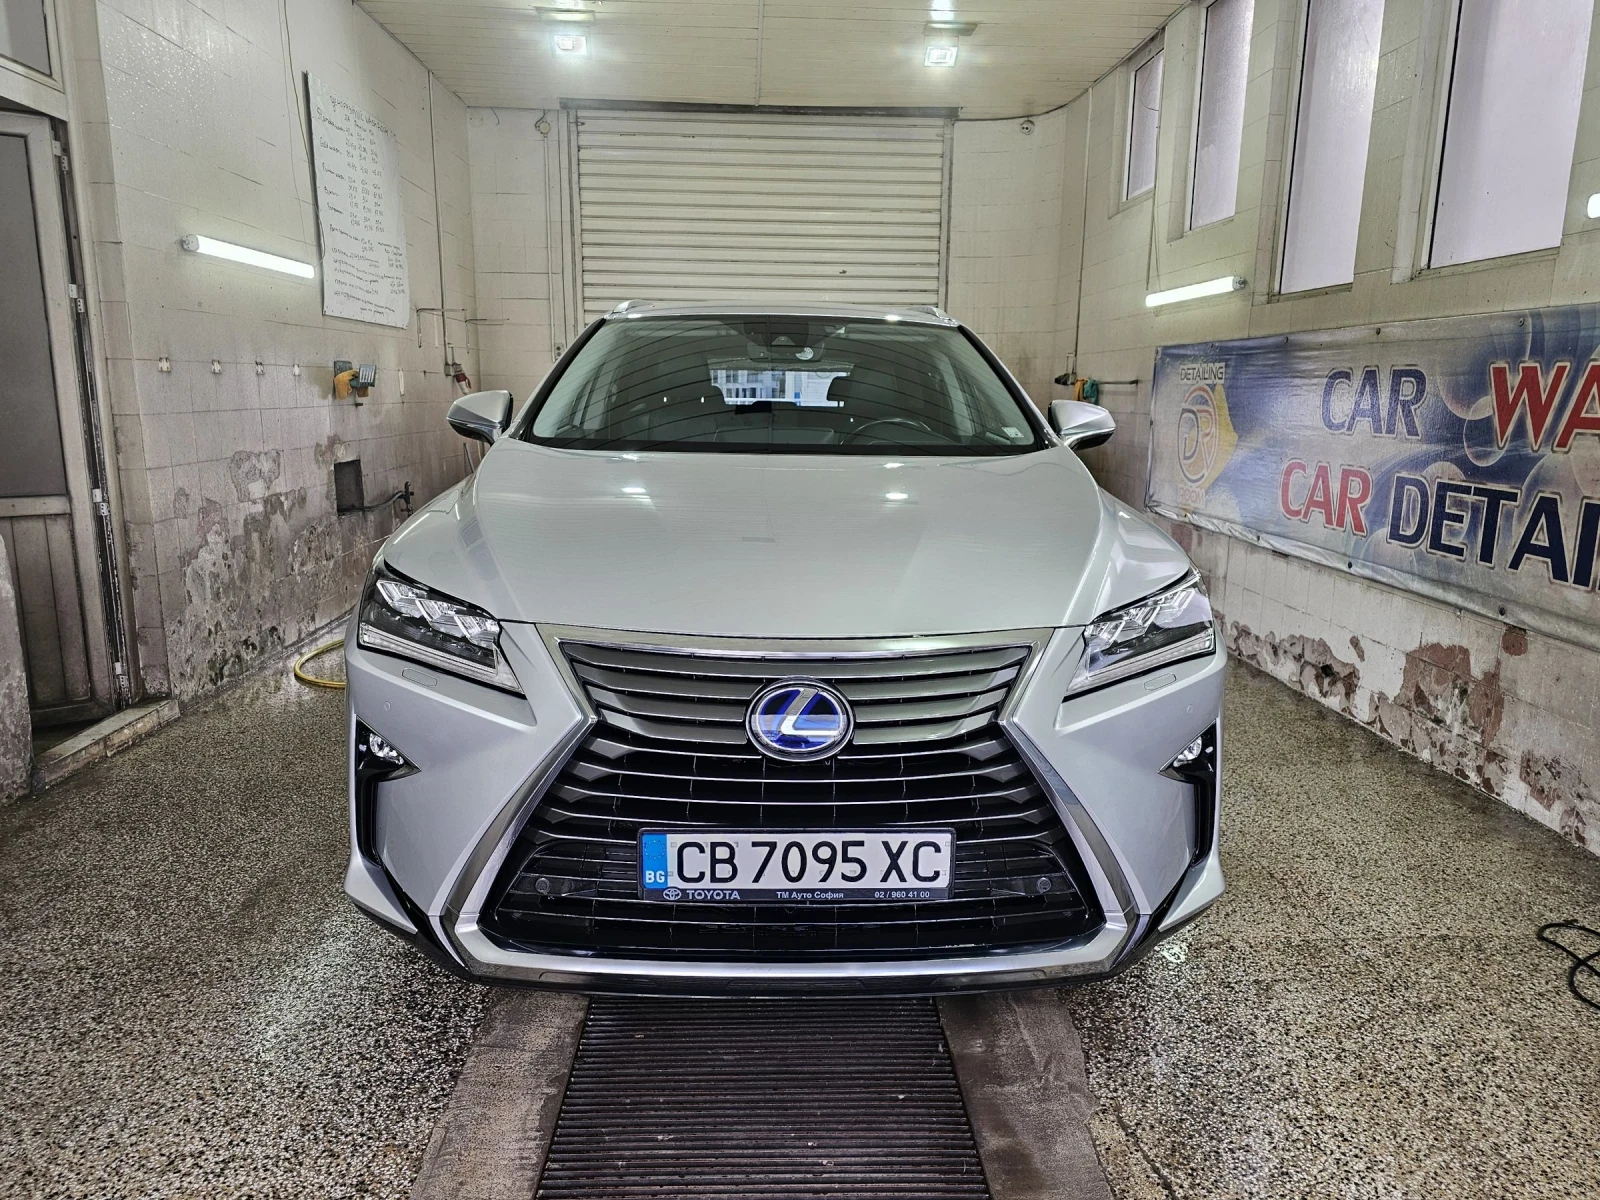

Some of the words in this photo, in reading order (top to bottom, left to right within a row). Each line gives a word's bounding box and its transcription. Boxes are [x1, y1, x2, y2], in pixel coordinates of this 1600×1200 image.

[1180, 364, 1225, 381] DETAILING
[1321, 366, 1428, 439] CAR
[1280, 459, 1373, 536] CAR
[1386, 472, 1600, 591] DETAI
[676, 841, 739, 884] CB
[751, 840, 868, 883] 7095
[879, 840, 942, 883] XC
[645, 870, 665, 883] BG
[686, 890, 741, 900] TOYOTA
[791, 891, 812, 901] Ауто
[814, 891, 844, 901] София
[874, 891, 885, 899] 02
[891, 891, 905, 899] 960
[908, 891, 918, 899] 41
[920, 891, 931, 899] 00
